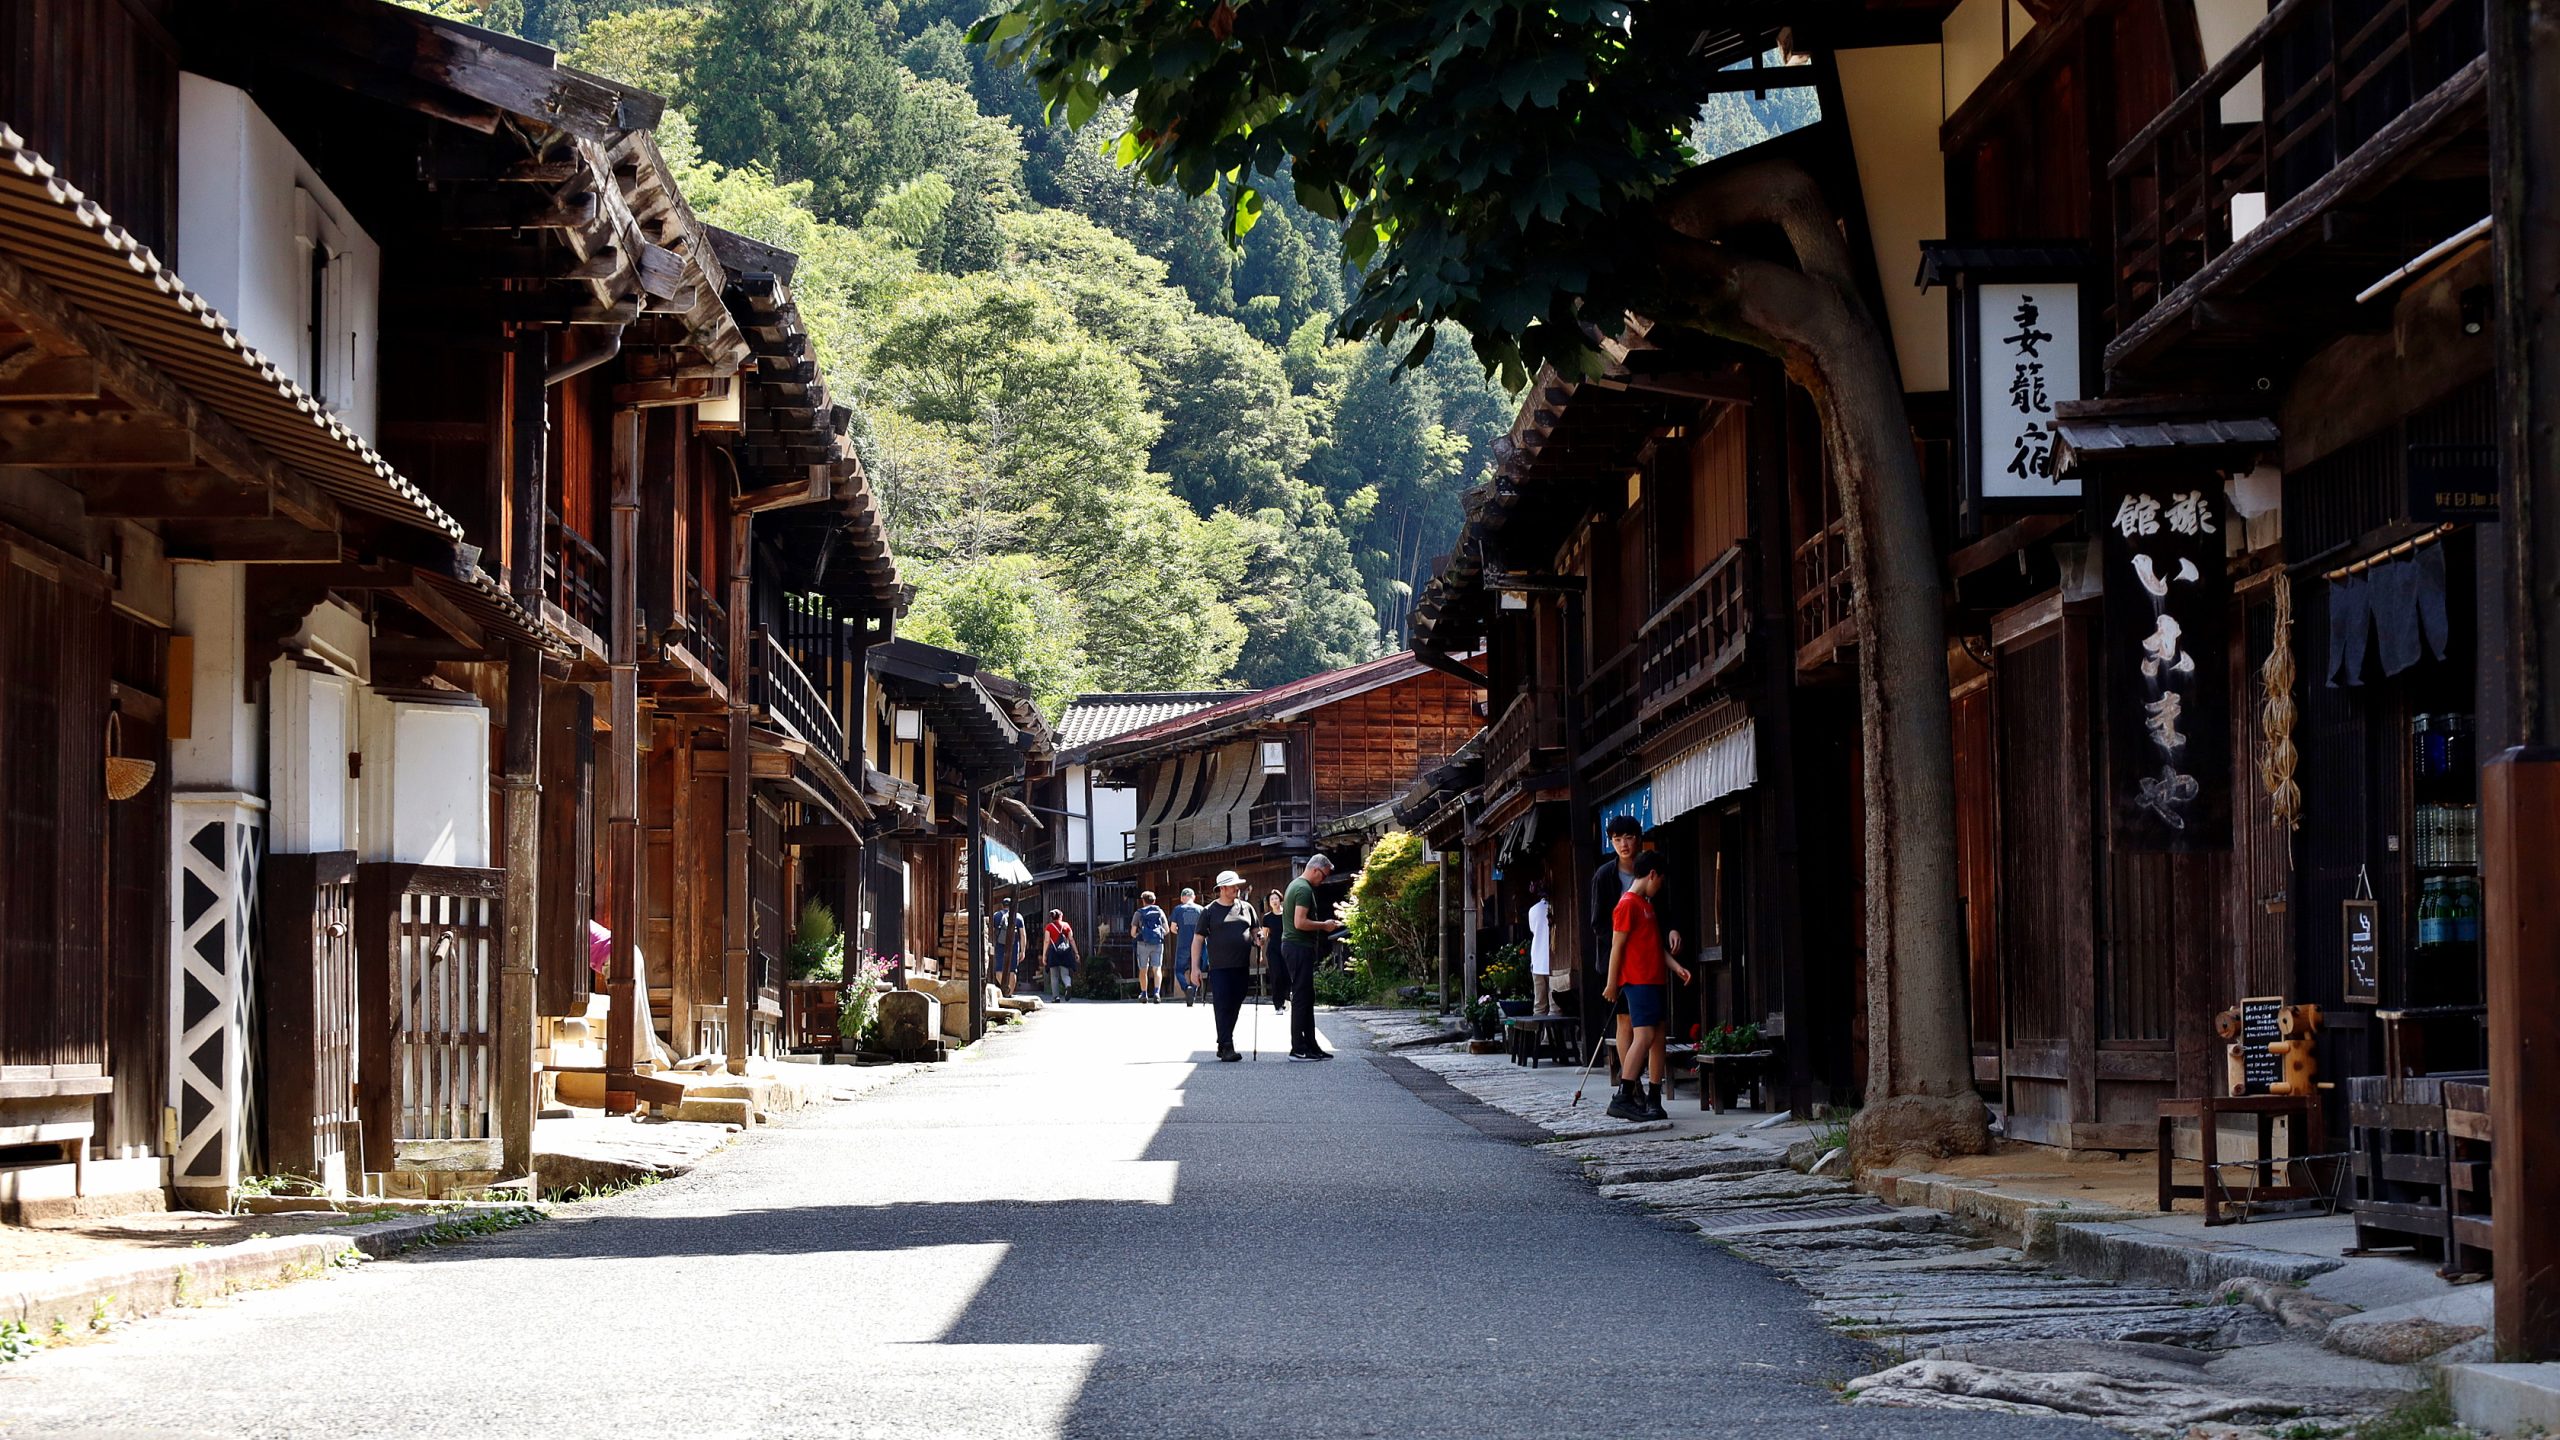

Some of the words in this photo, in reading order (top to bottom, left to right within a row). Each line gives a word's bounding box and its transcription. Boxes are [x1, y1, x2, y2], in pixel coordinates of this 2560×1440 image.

[2003, 294, 2053, 480] 妻籠宿
[2112, 489, 2217, 538] 旅館
